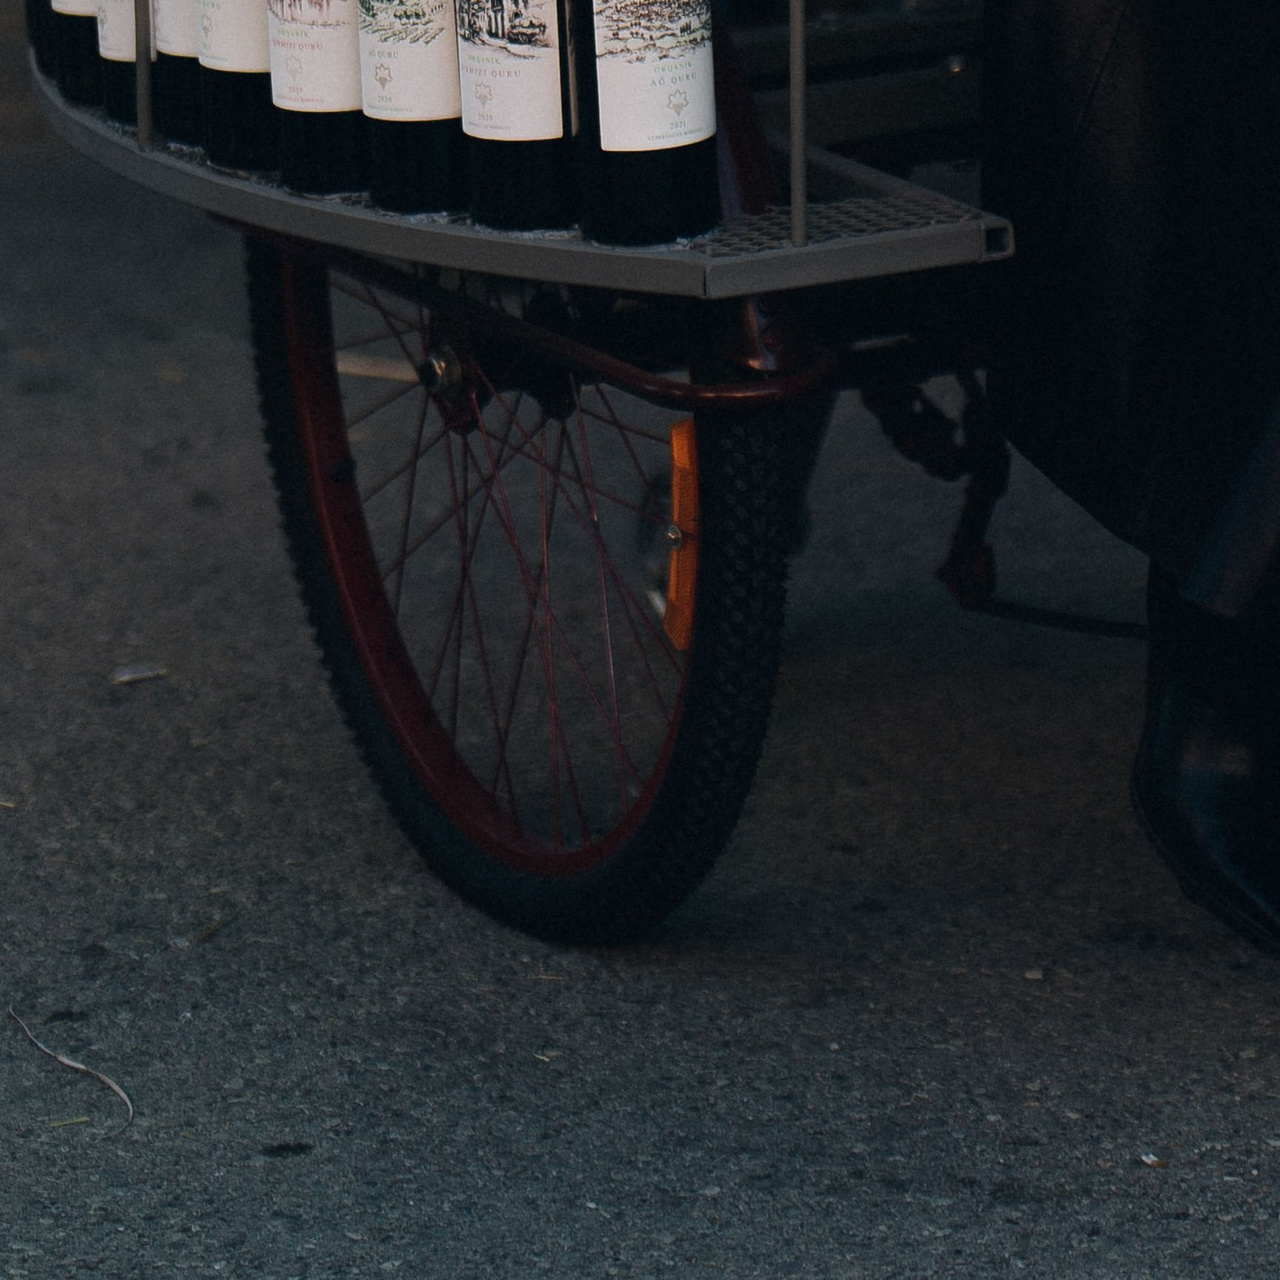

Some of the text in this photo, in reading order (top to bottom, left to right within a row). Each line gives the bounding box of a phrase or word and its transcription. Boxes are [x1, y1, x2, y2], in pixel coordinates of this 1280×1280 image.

[491, 66, 523, 79] QURU
[653, 60, 694, 74] ORQANİK
[650, 75, 667, 88] AĞ
